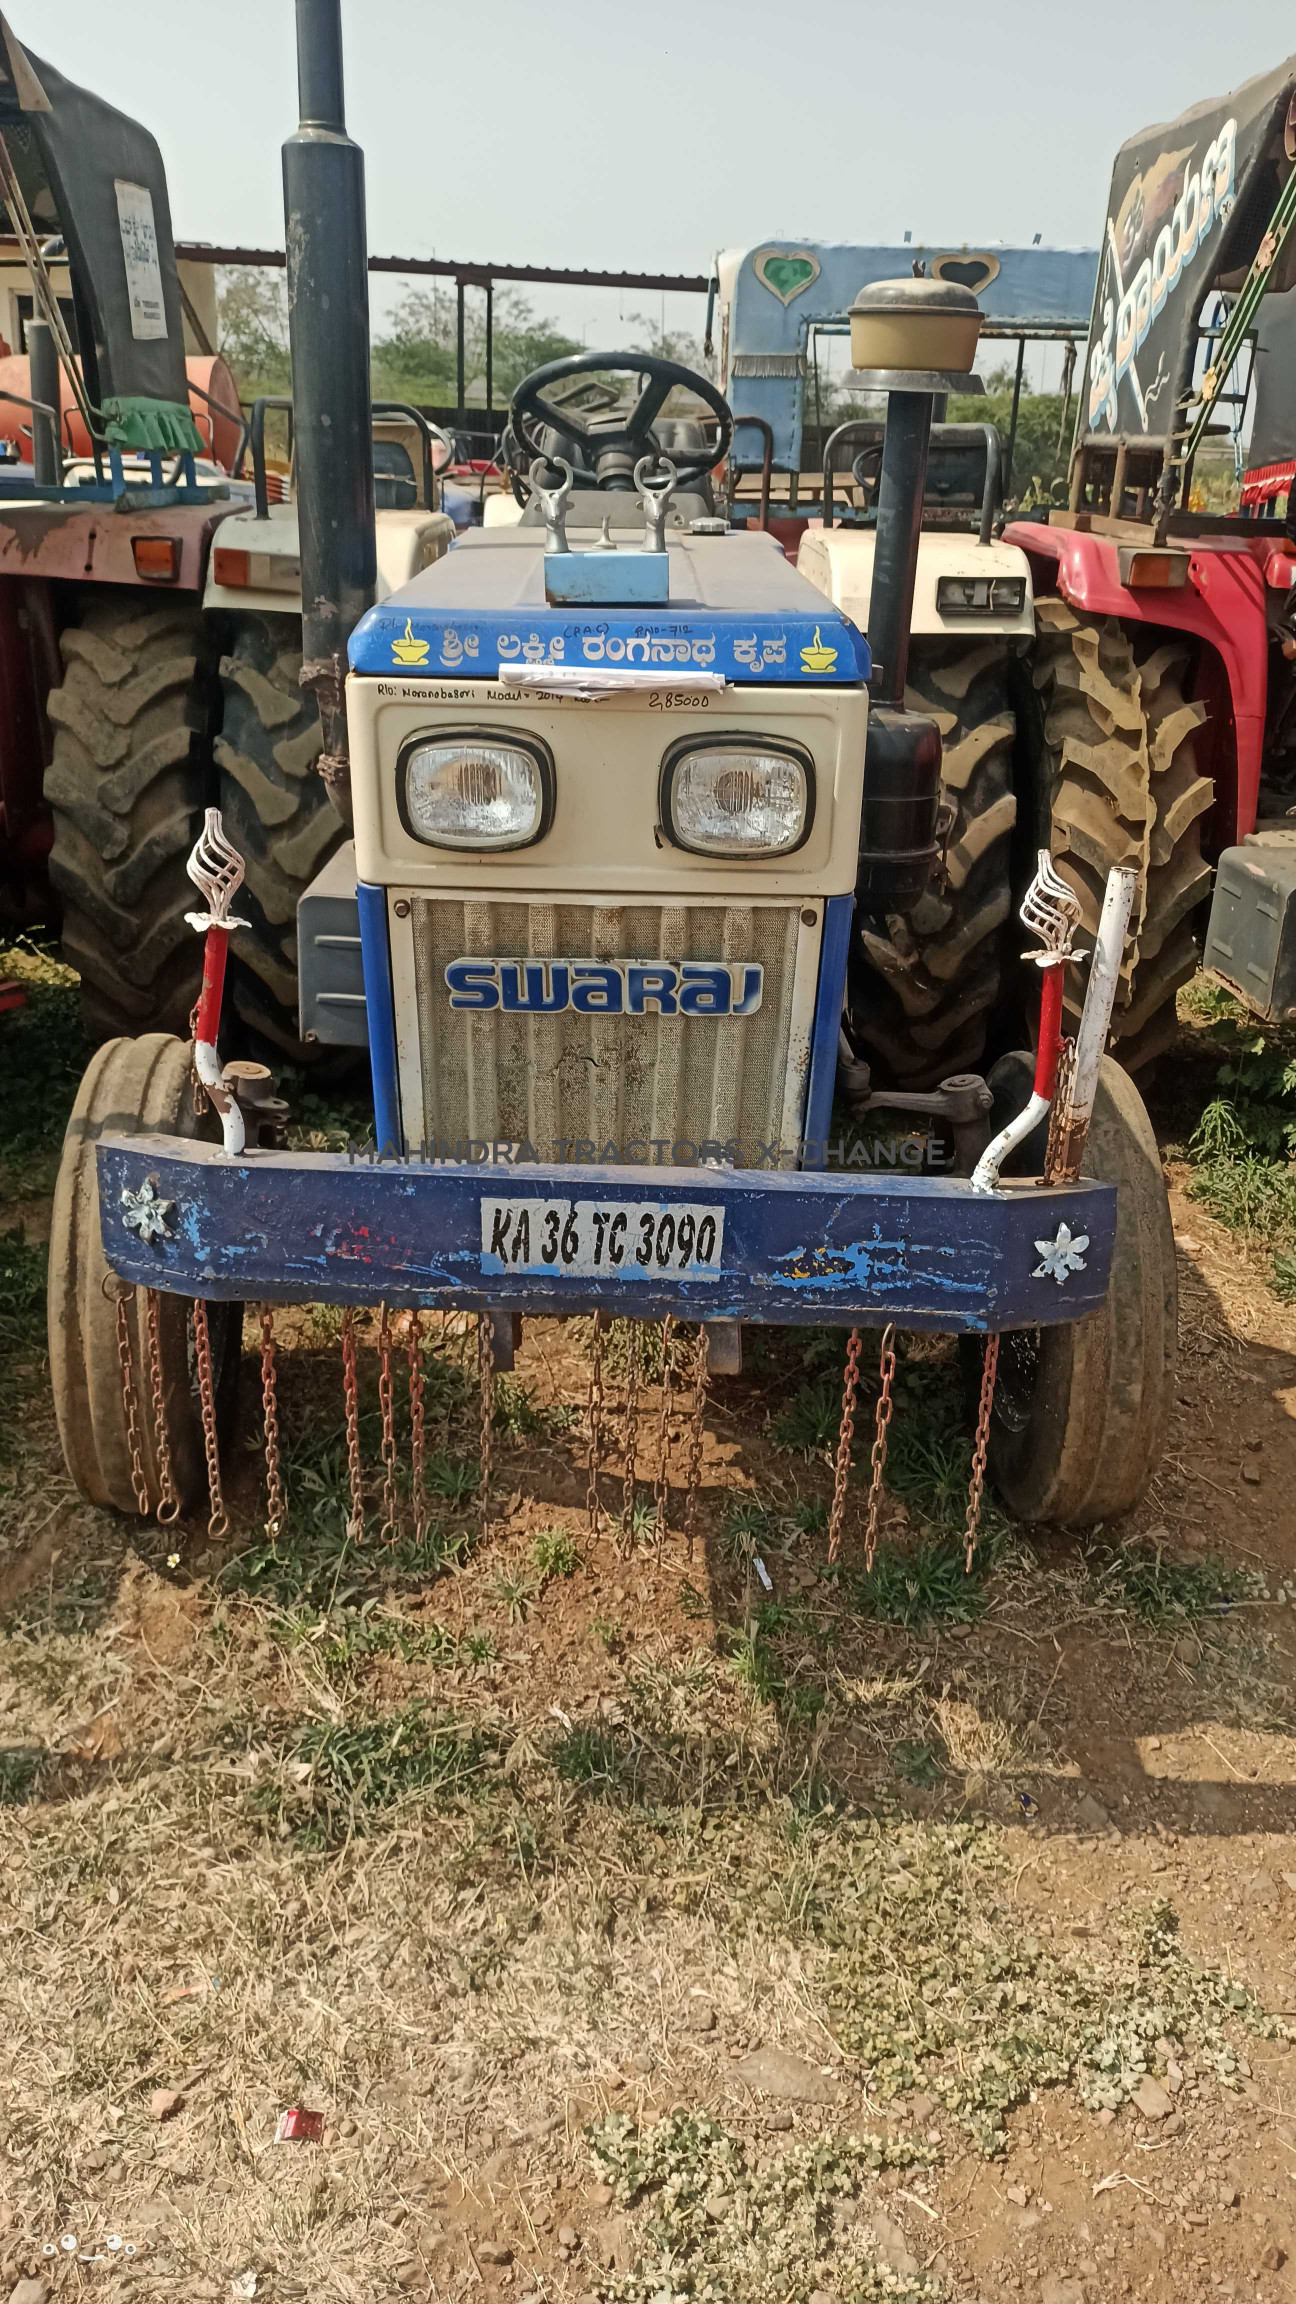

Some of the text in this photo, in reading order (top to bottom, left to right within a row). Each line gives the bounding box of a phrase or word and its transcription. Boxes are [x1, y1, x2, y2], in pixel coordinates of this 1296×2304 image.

[439, 629, 479, 667] ಶ್ರೀ
[582, 632, 716, 668] ರಂಗನಾಥ
[490, 1207, 716, 1269] KA 36 TC 3090
